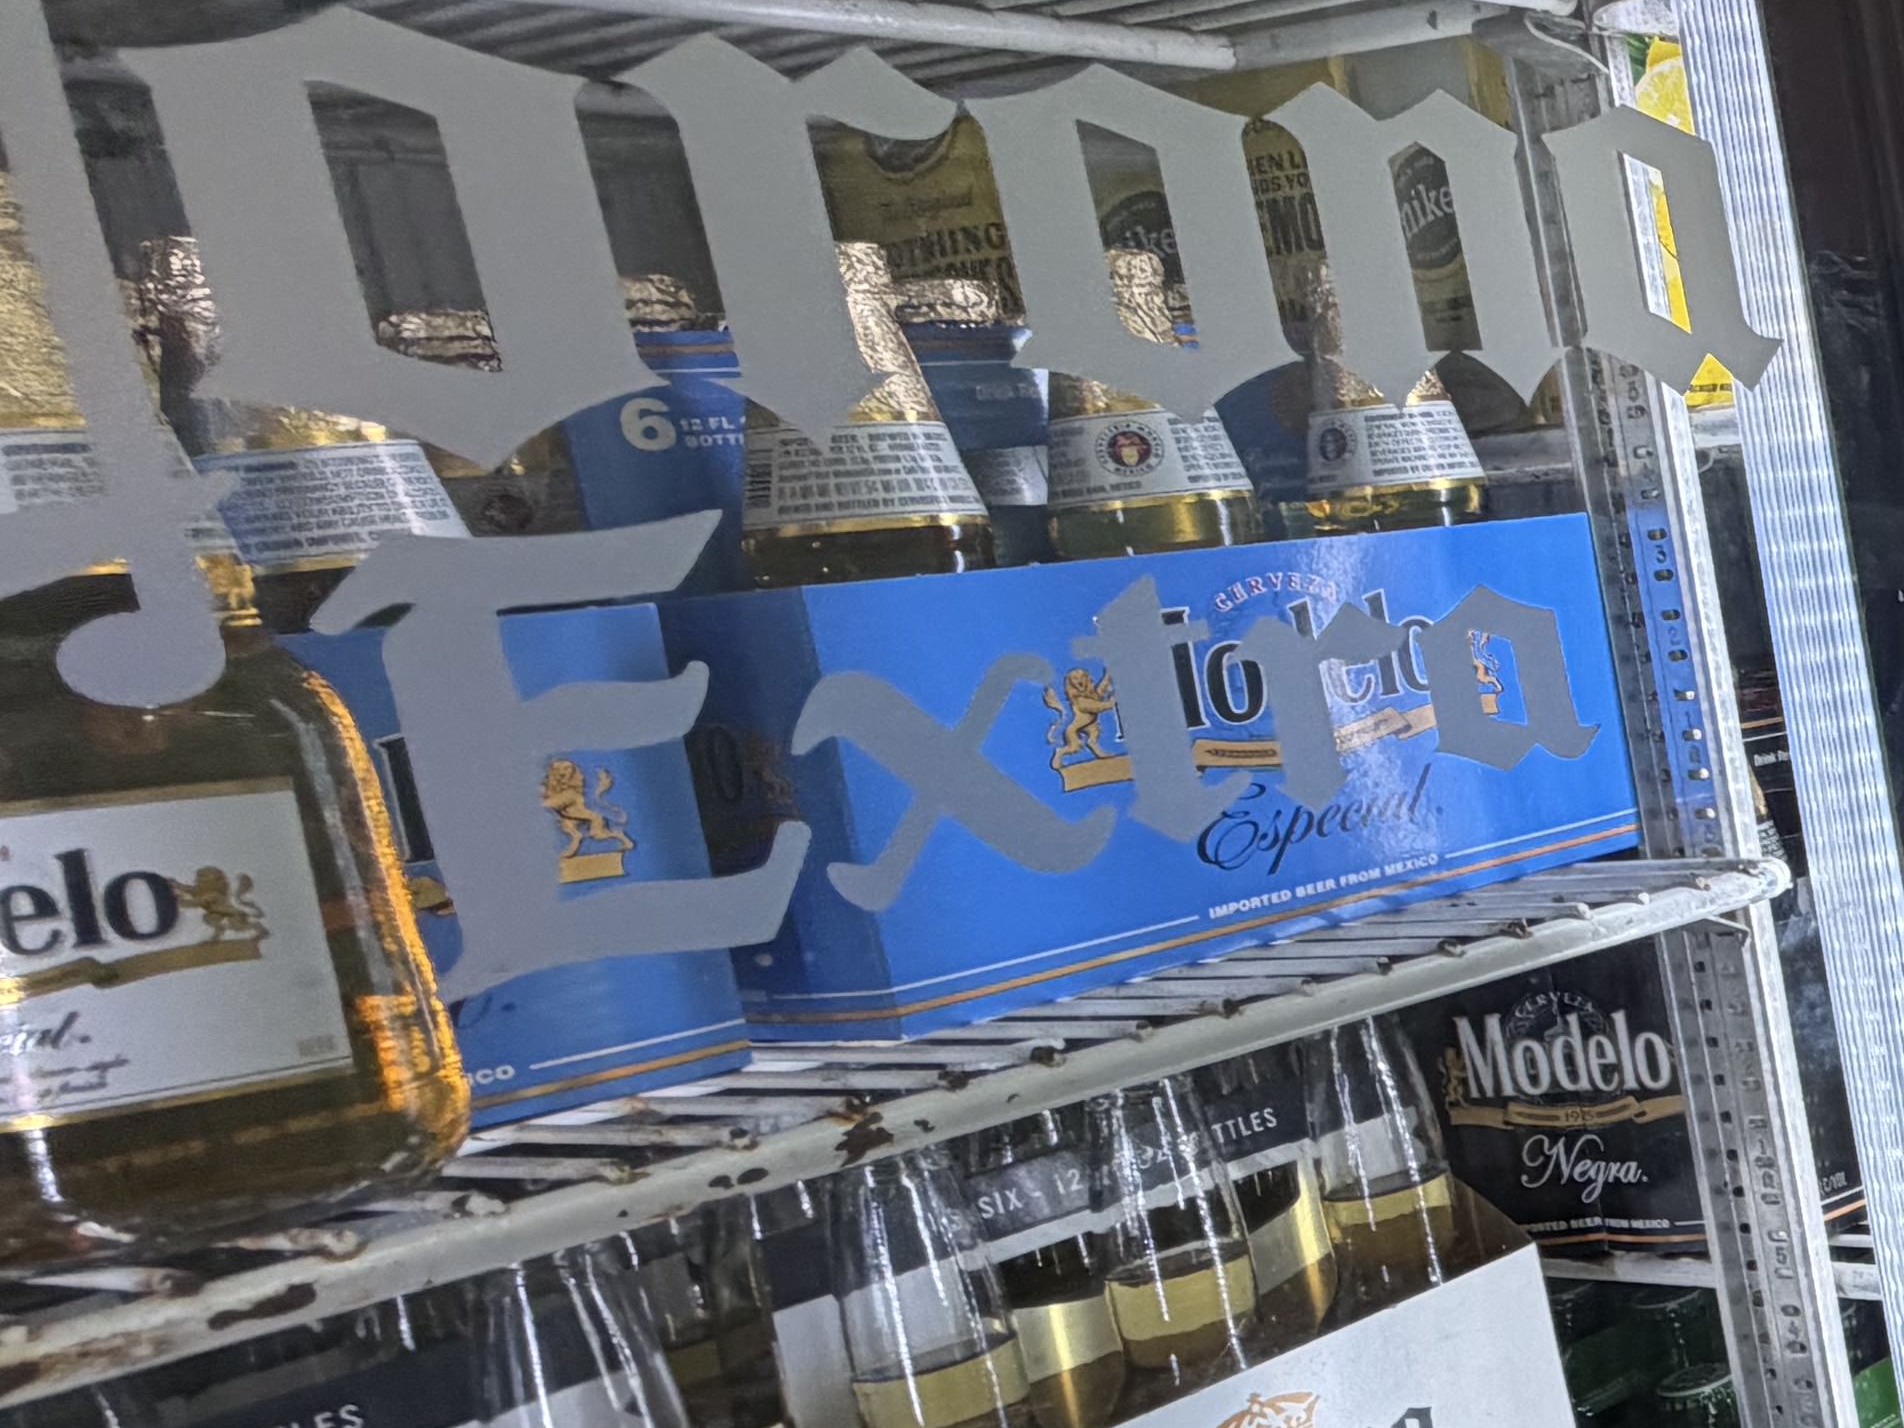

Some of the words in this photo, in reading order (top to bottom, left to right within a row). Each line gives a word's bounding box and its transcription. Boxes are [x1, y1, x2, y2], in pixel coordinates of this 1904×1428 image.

[620, 398, 676, 451] 6
[310, 509, 1600, 1000] Extra
[0, 849, 180, 957] elo
[1209, 888, 1292, 919] IMPORTED
[1295, 880, 1336, 900] BEER
[1340, 869, 1380, 890] FROM
[1383, 853, 1439, 880] MEXICO
[1453, 1011, 1673, 1100] Modelo
[1213, 1108, 1278, 1143] TTLES
[1526, 1218, 1572, 1234] PORTED
